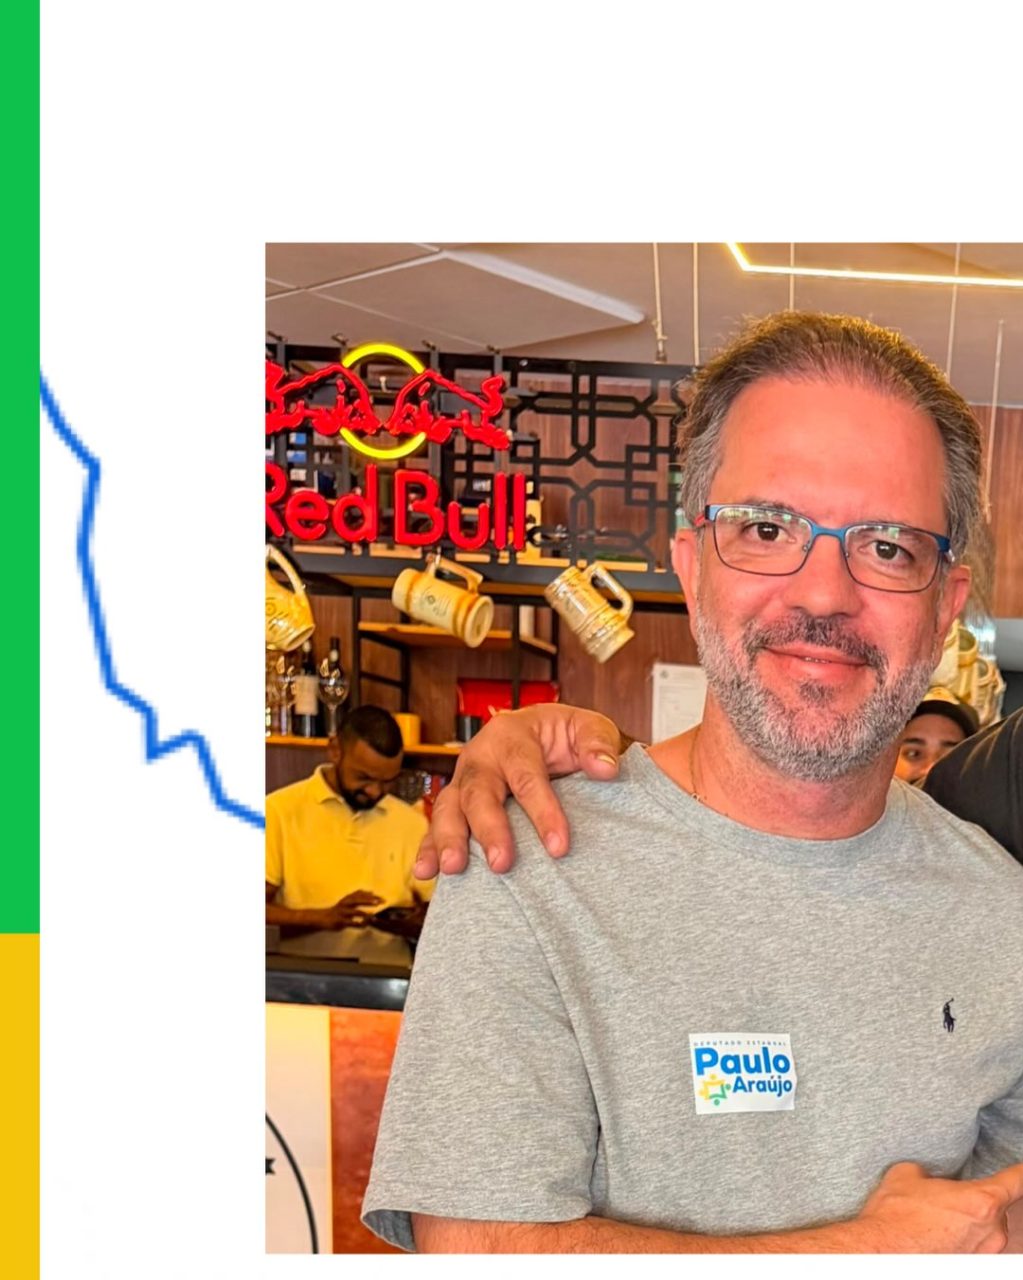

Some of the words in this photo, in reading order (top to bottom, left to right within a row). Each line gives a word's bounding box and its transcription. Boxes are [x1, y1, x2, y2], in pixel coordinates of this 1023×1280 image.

[394, 469, 526, 551] Bull
[694, 1046, 791, 1076] Paulo
[732, 1075, 793, 1098] Araújo
